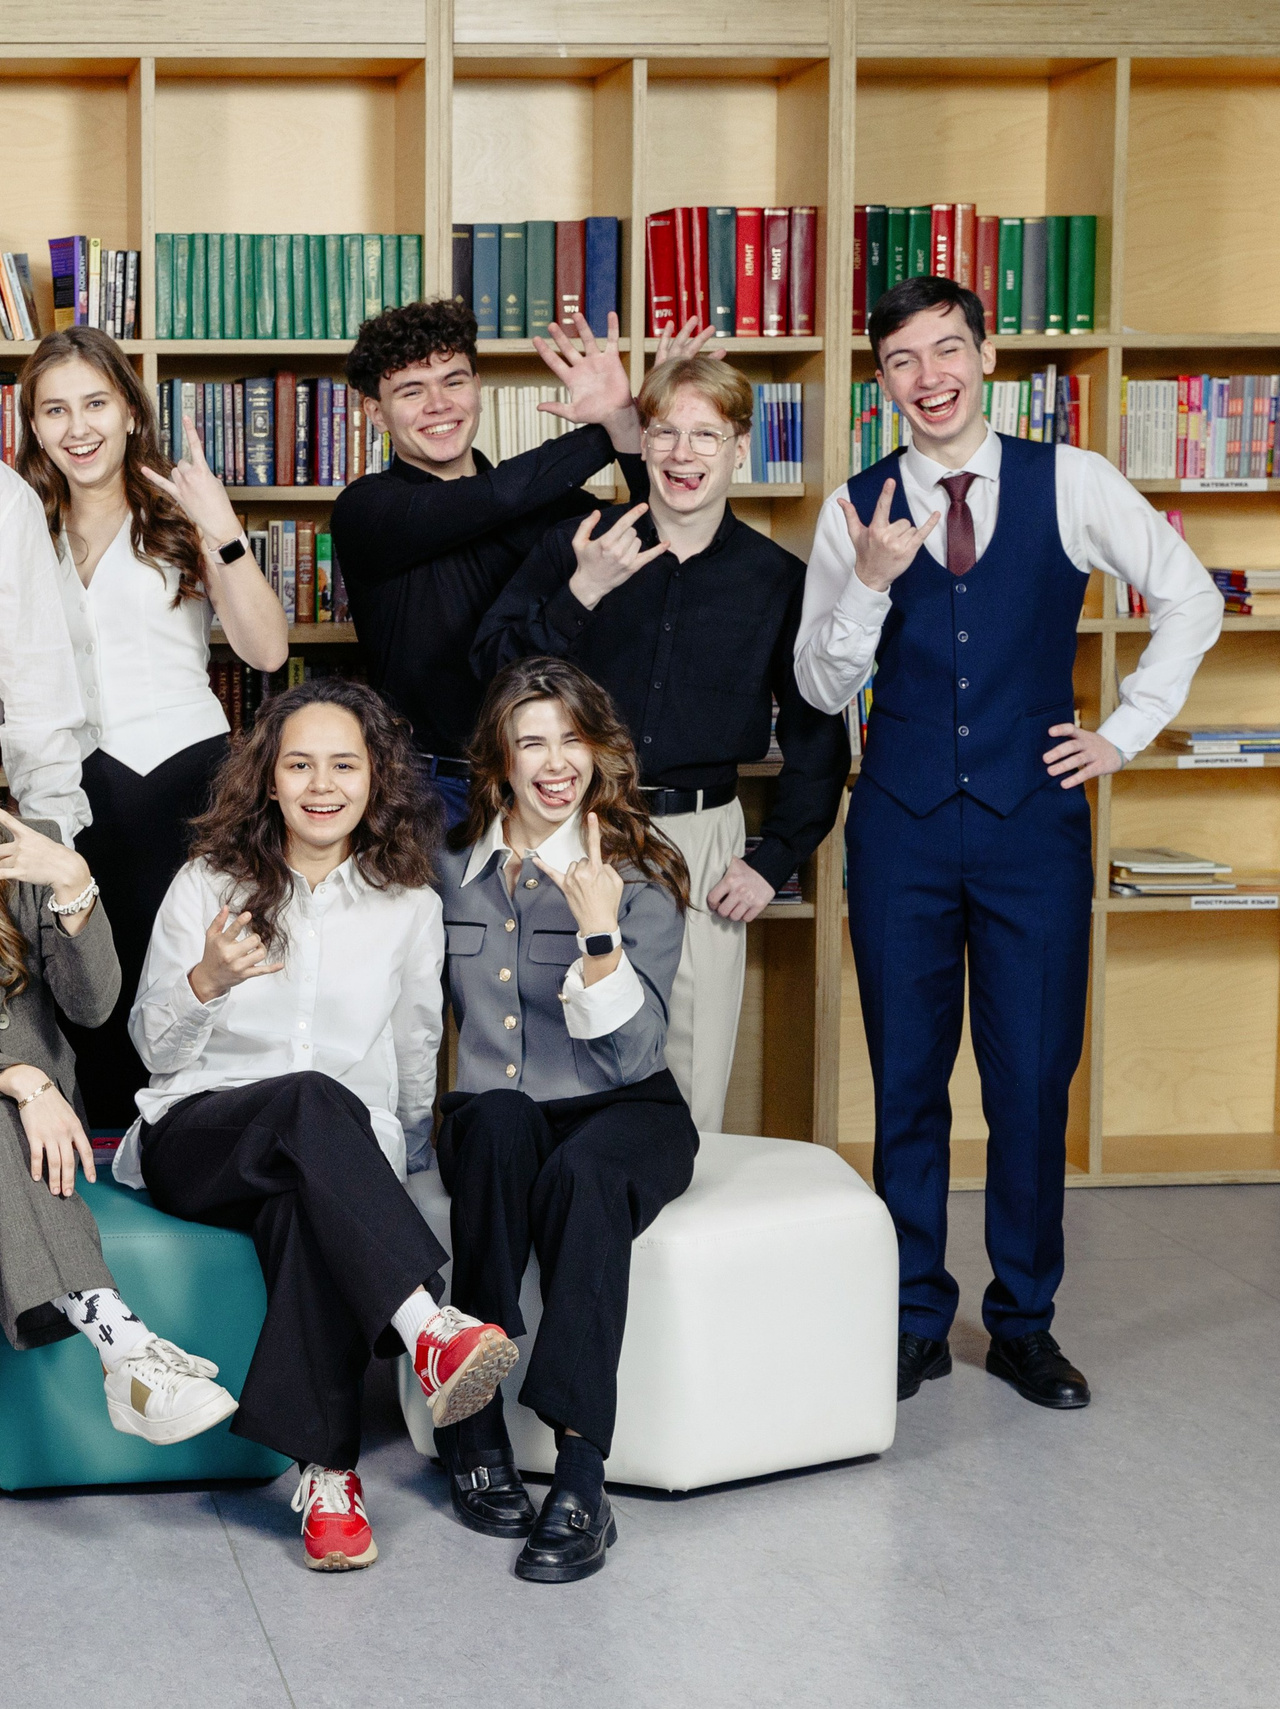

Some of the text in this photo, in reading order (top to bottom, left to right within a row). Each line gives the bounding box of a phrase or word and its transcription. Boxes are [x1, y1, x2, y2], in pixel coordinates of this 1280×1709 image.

[744, 244, 755, 276] КВАНТ
[771, 247, 782, 281] КВАНТ
[894, 246, 903, 281] ВАНТ
